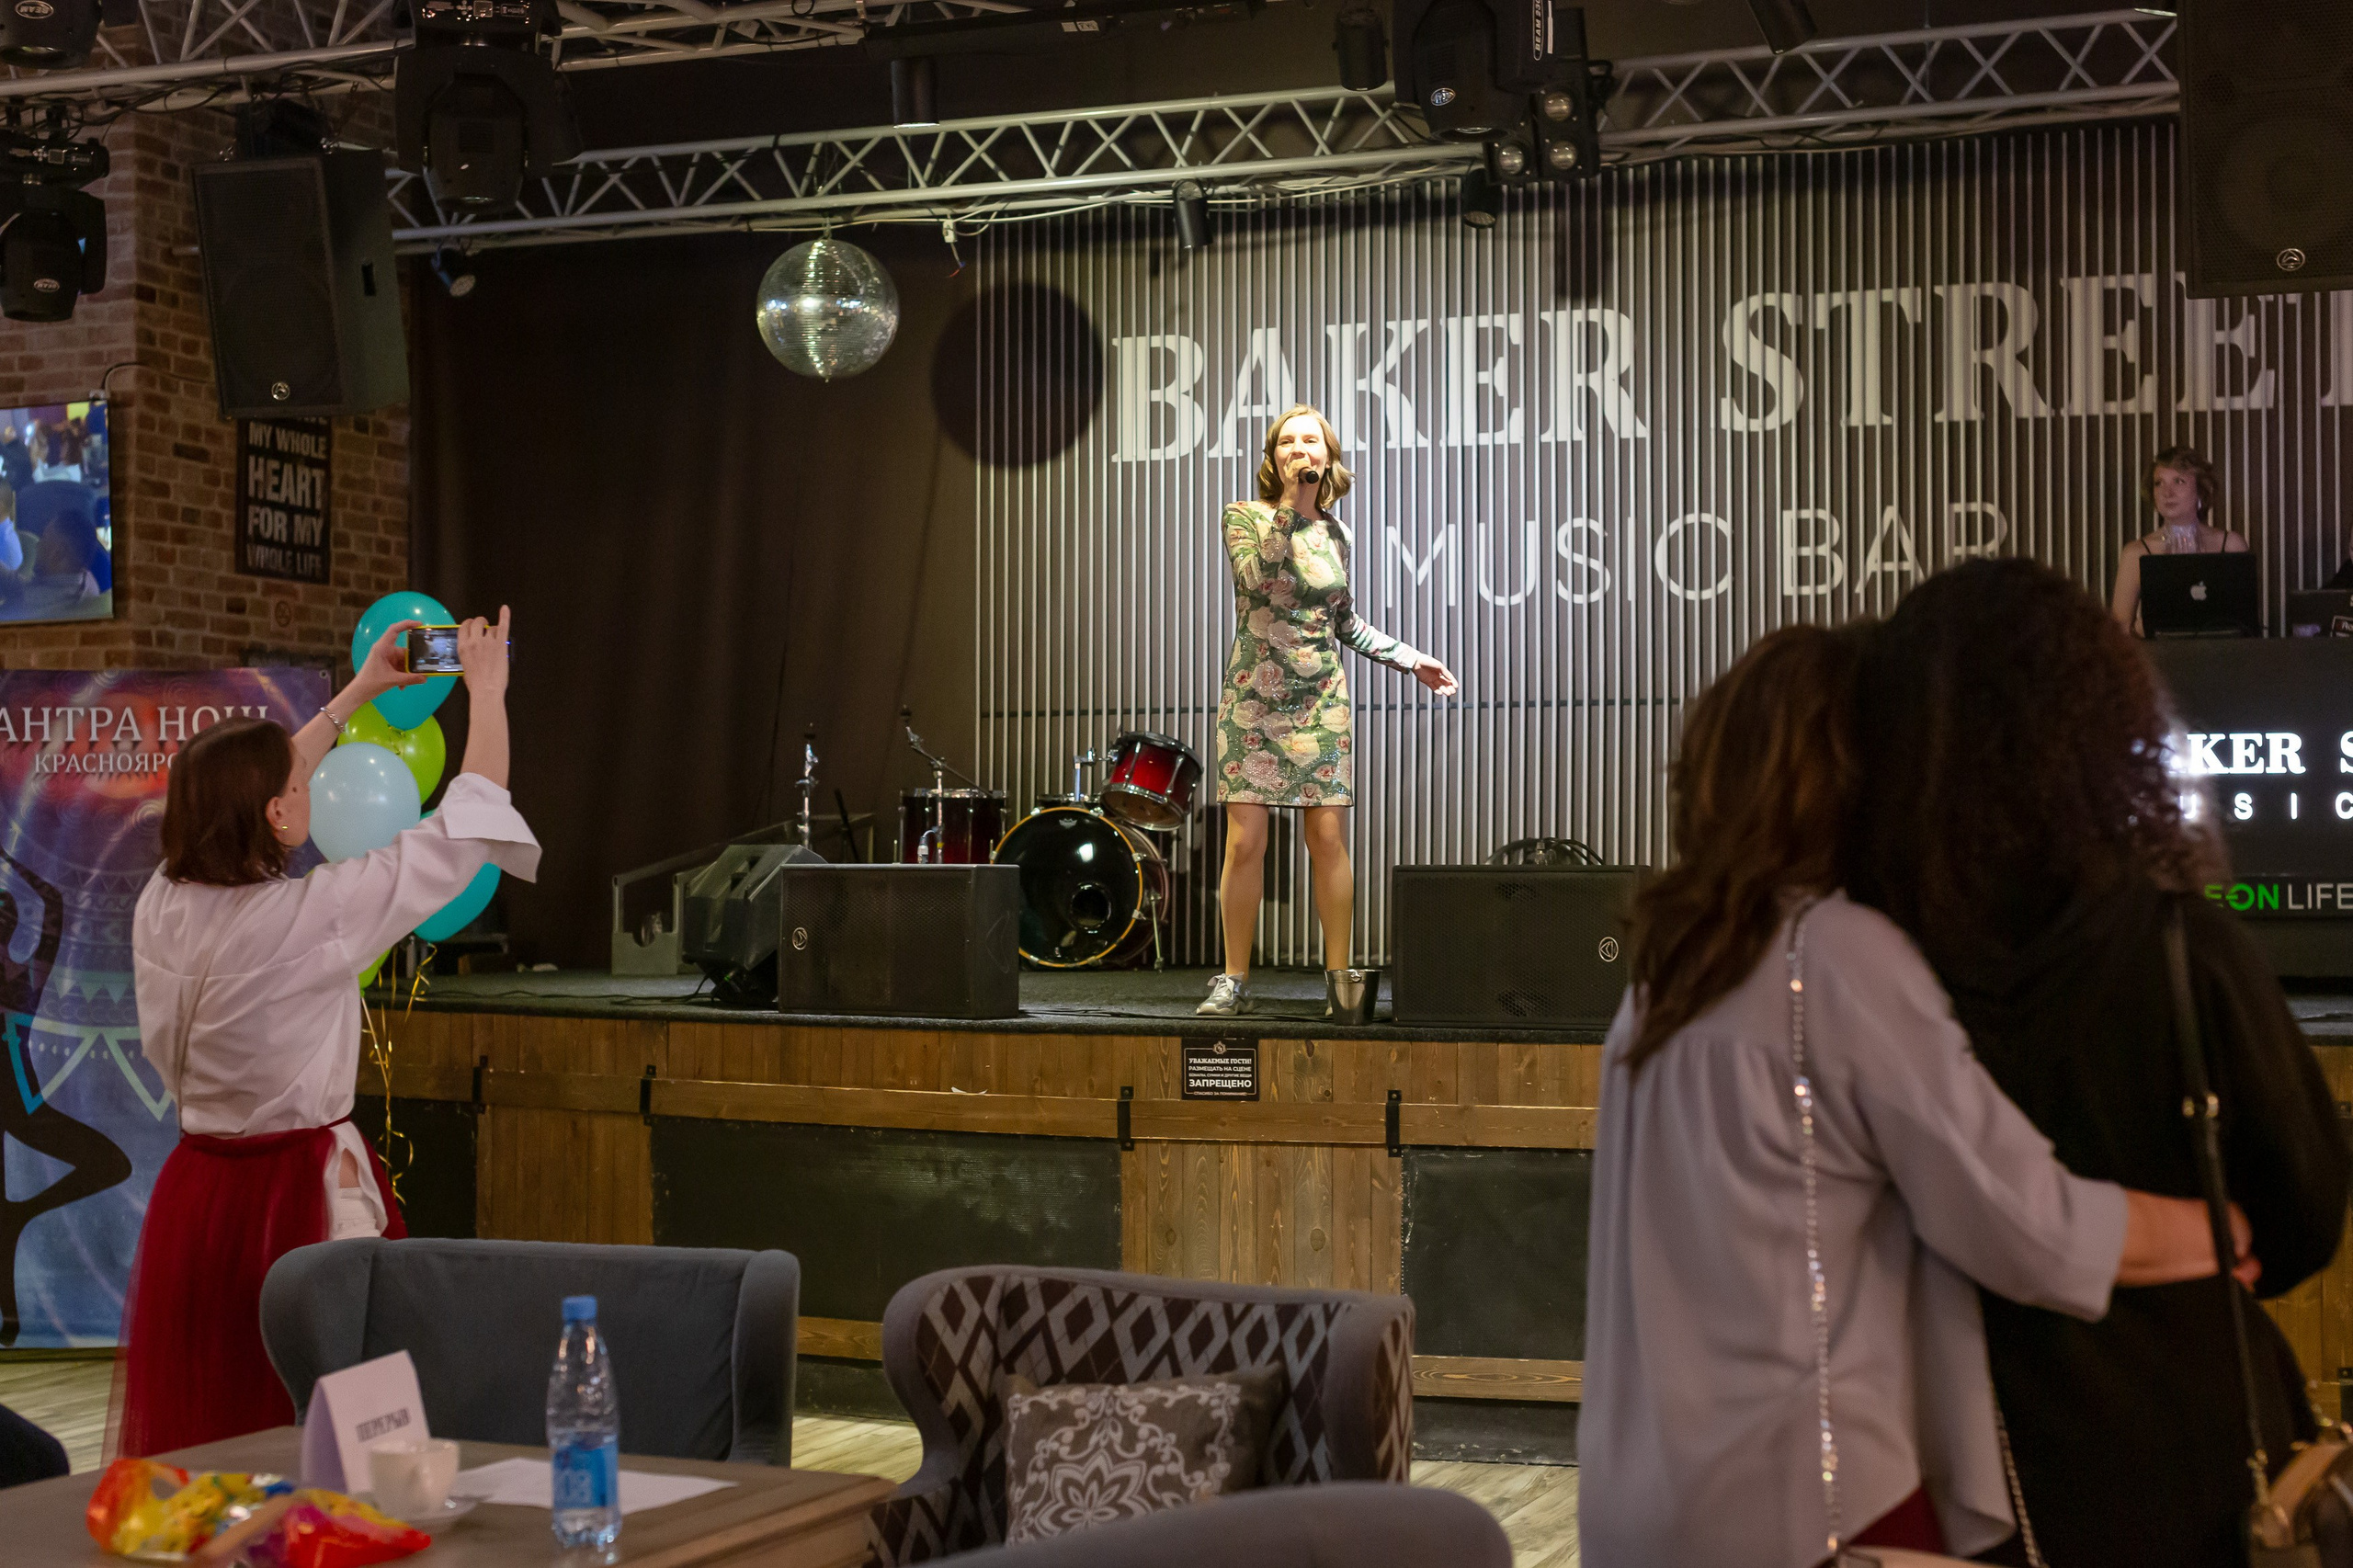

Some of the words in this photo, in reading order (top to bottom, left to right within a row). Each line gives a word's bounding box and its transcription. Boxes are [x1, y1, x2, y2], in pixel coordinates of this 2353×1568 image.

[1111, 308, 1648, 462] BAKER
[249, 421, 273, 449] MY
[276, 426, 326, 460] WHOLE
[248, 455, 325, 510] HEART
[247, 505, 288, 543] FOR
[293, 514, 324, 547] MY
[1386, 512, 1734, 608] MUSIC
[1782, 502, 2008, 597] BAR
[2169, 732, 2307, 775] KER
[2288, 882, 2353, 910] LIFE
[1188, 1079, 1252, 1088] ЗАПРЕЩЕНО
